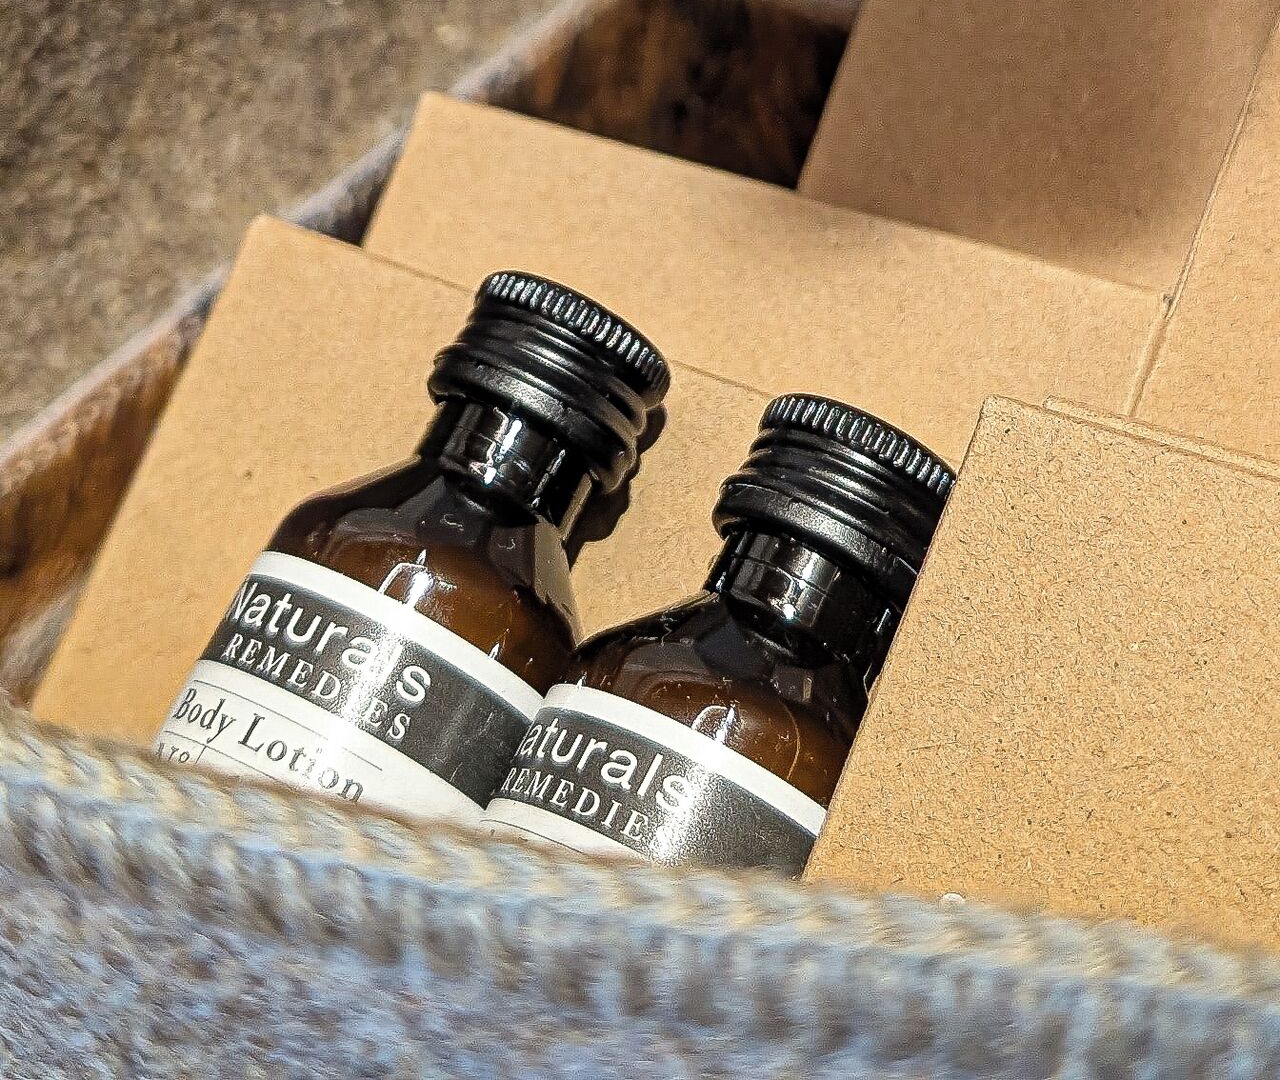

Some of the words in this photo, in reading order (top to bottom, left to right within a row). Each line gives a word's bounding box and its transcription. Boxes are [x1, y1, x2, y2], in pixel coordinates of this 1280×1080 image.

[221, 633, 412, 741] REMEDES
[229, 580, 432, 703] Naturals
[172, 687, 237, 744] Body
[237, 712, 365, 804] Lotion
[515, 717, 692, 815] aturals
[501, 767, 668, 854] REMEDIE
